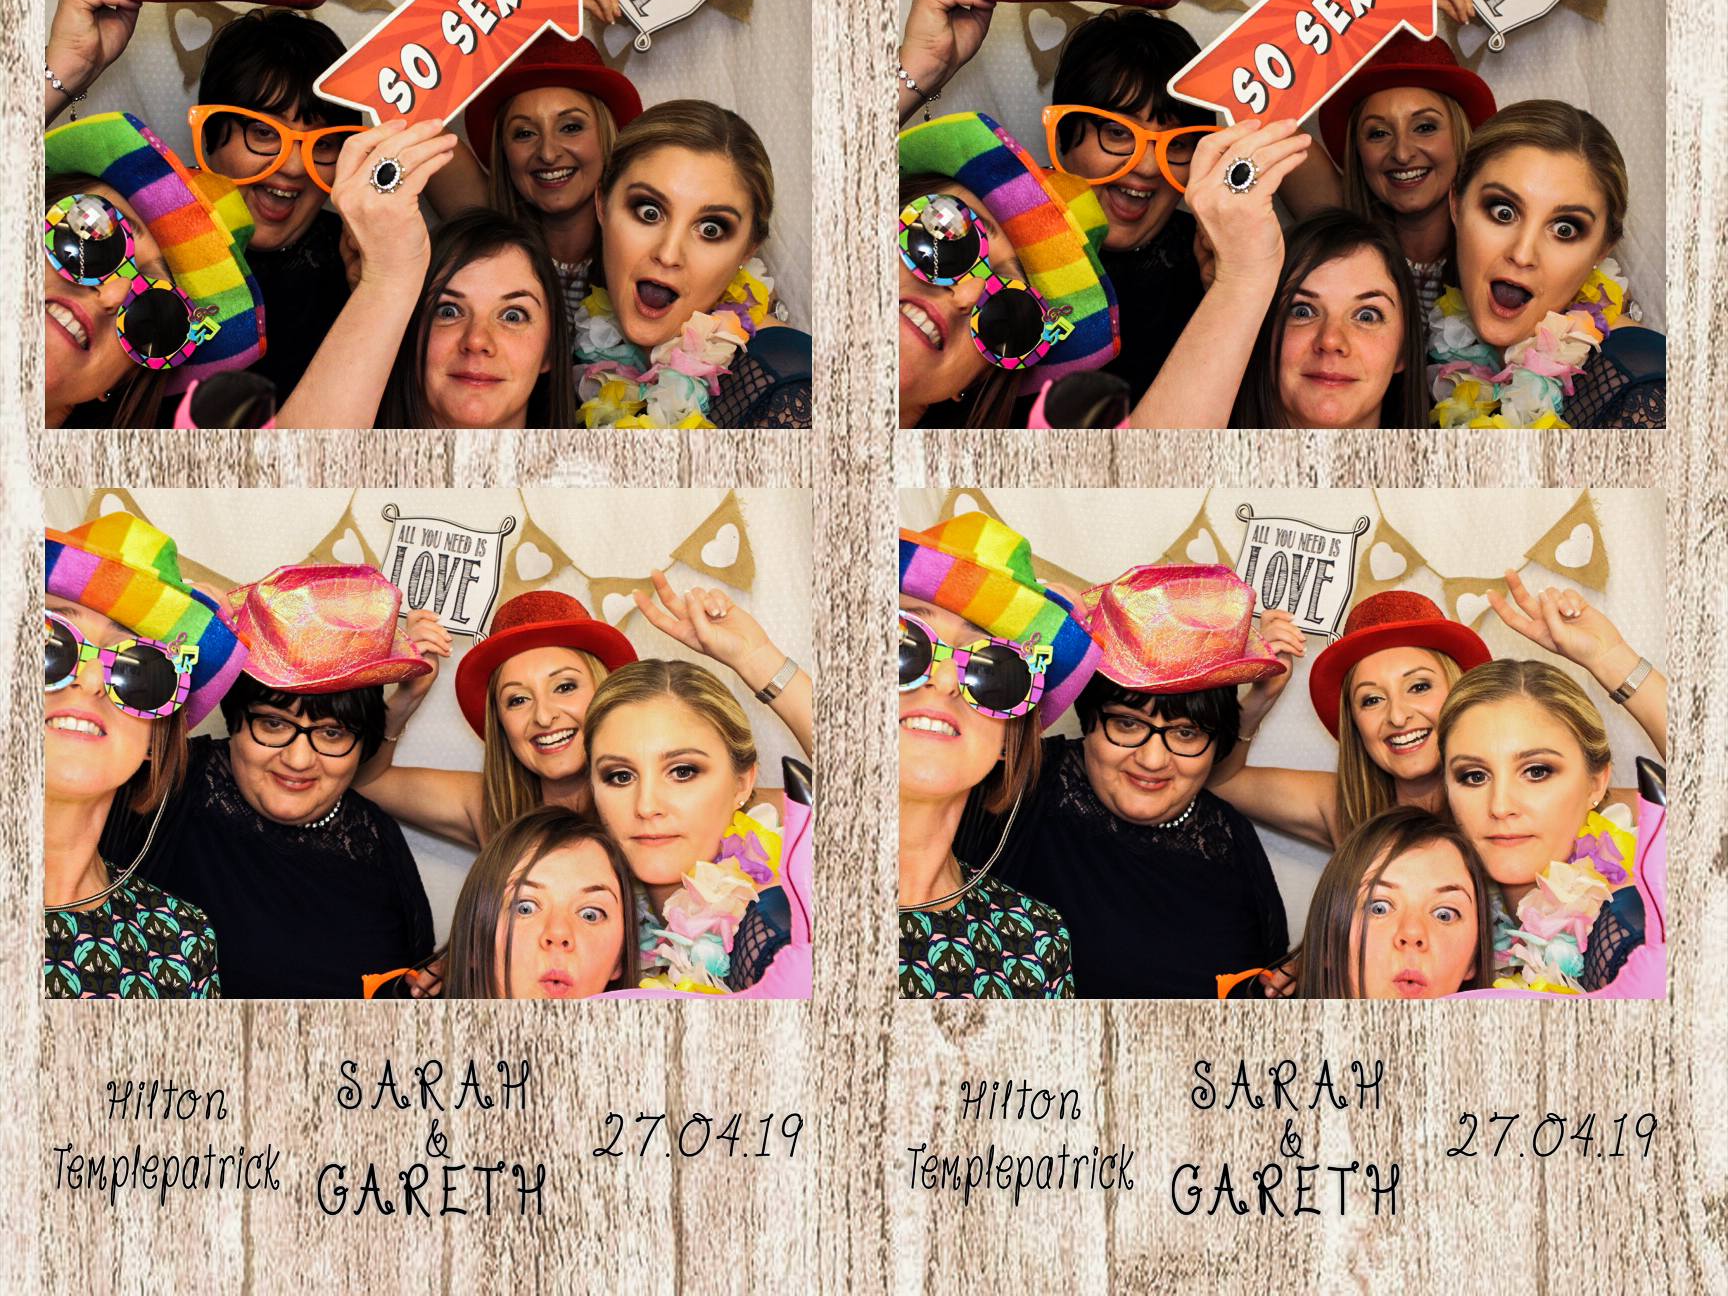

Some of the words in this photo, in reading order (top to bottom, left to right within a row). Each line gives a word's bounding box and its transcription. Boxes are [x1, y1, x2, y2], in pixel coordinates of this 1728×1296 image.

[378, 41, 442, 115] SO
[1232, 41, 1296, 115] SO
[397, 524, 417, 545] ALL
[421, 527, 443, 549] YOU
[443, 532, 473, 555] NEED
[474, 537, 488, 557] IS
[1251, 524, 1271, 545] ALL
[1275, 527, 1297, 549] YOU
[1297, 532, 1327, 555] NEED
[1328, 537, 1342, 557] IS
[390, 545, 482, 625] LOVE
[1244, 545, 1336, 625] LOVE
